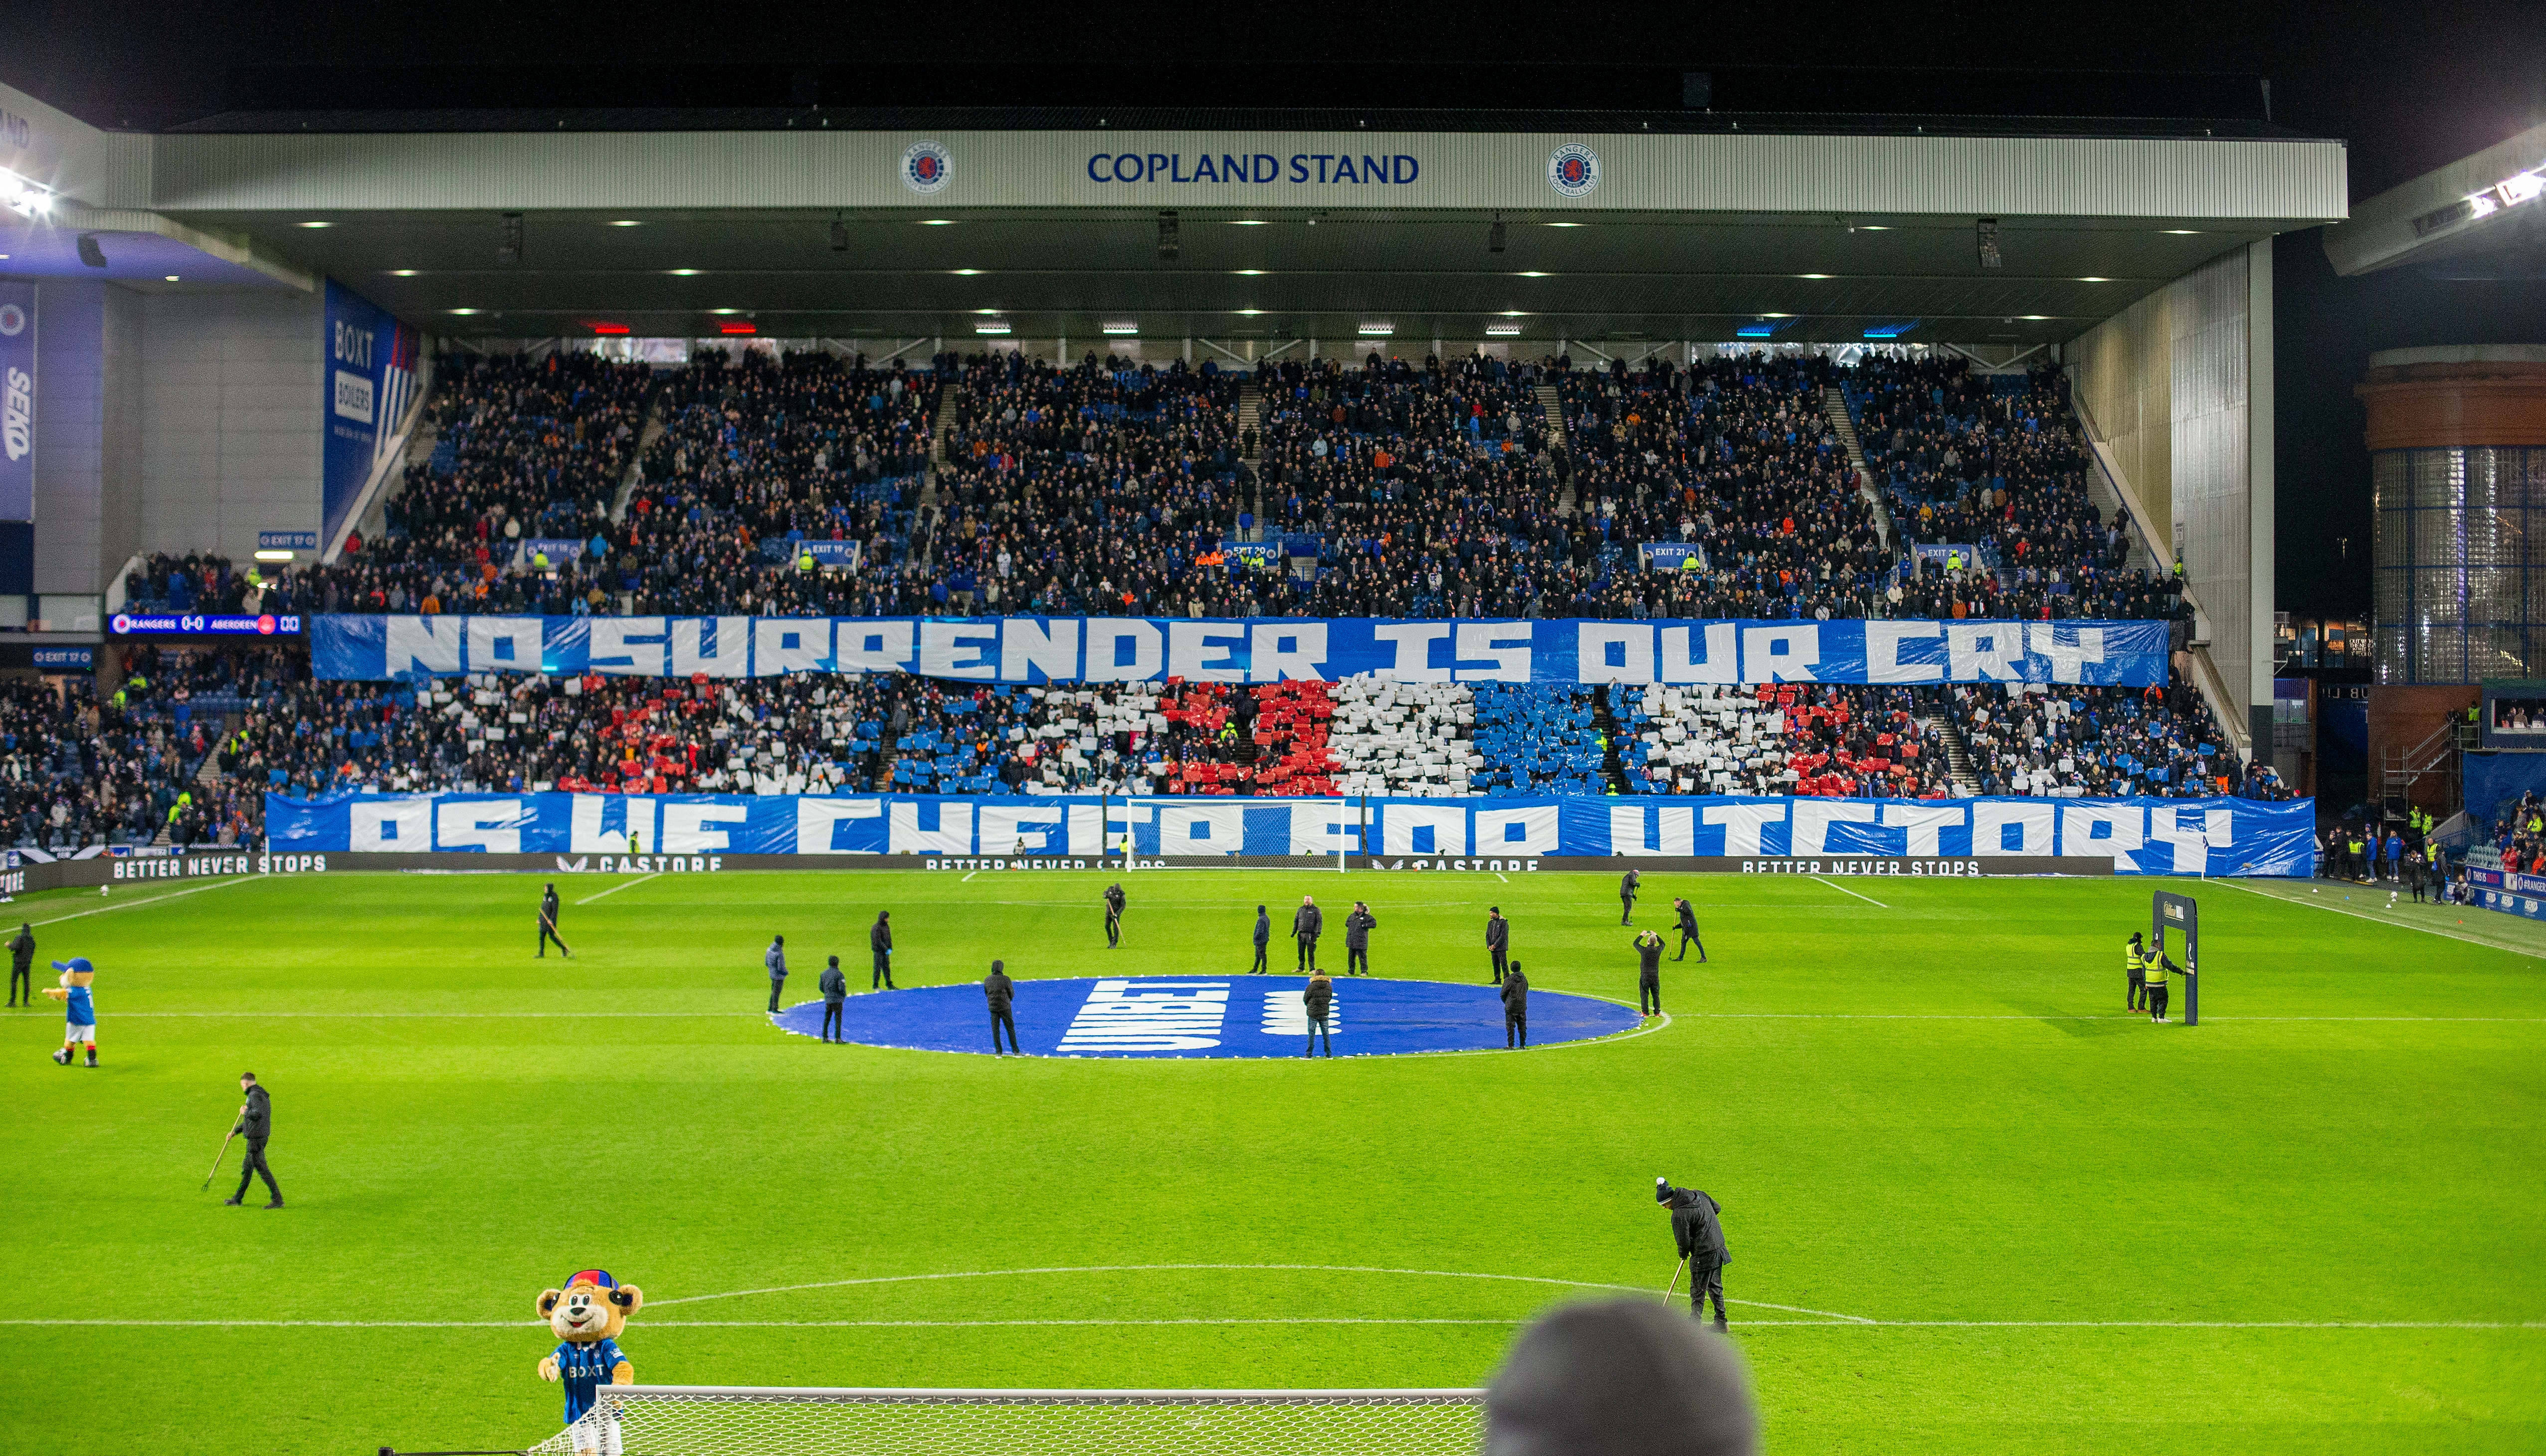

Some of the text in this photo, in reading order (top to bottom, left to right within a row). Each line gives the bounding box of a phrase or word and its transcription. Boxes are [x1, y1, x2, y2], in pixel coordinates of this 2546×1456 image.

[1553, 146, 1595, 161] RANGERS
[1088, 153, 1419, 184] COPLAND STAND
[1551, 175, 1597, 194] FOOTBALL CLUB
[335, 321, 374, 370] BOXT
[4, 366, 31, 461] SEKO
[271, 535, 291, 546] EXIT
[131, 619, 177, 629] RANGERS
[181, 615, 204, 631] 0-0
[210, 619, 258, 630] ABERDEEN
[45, 651, 66, 662] EXIT
[386, 615, 2105, 685] NO SURRENDER IS OUR CRY
[570, 793, 747, 854] WE
[113, 854, 326, 879] BETTER NEVER STOPS
[599, 856, 722, 872] CASTORE
[926, 859, 1006, 870] BETTER
[1017, 859, 1085, 870] NEVER
[1415, 859, 1538, 872] CASTORE
[1743, 861, 1979, 875] BETTER NEVER STOPS
[2473, 871, 2482, 881] THIS
[2482, 873, 2487, 882] IS
[1056, 980, 1231, 1052] UNIBET
[569, 1364, 604, 1378] BOXT
